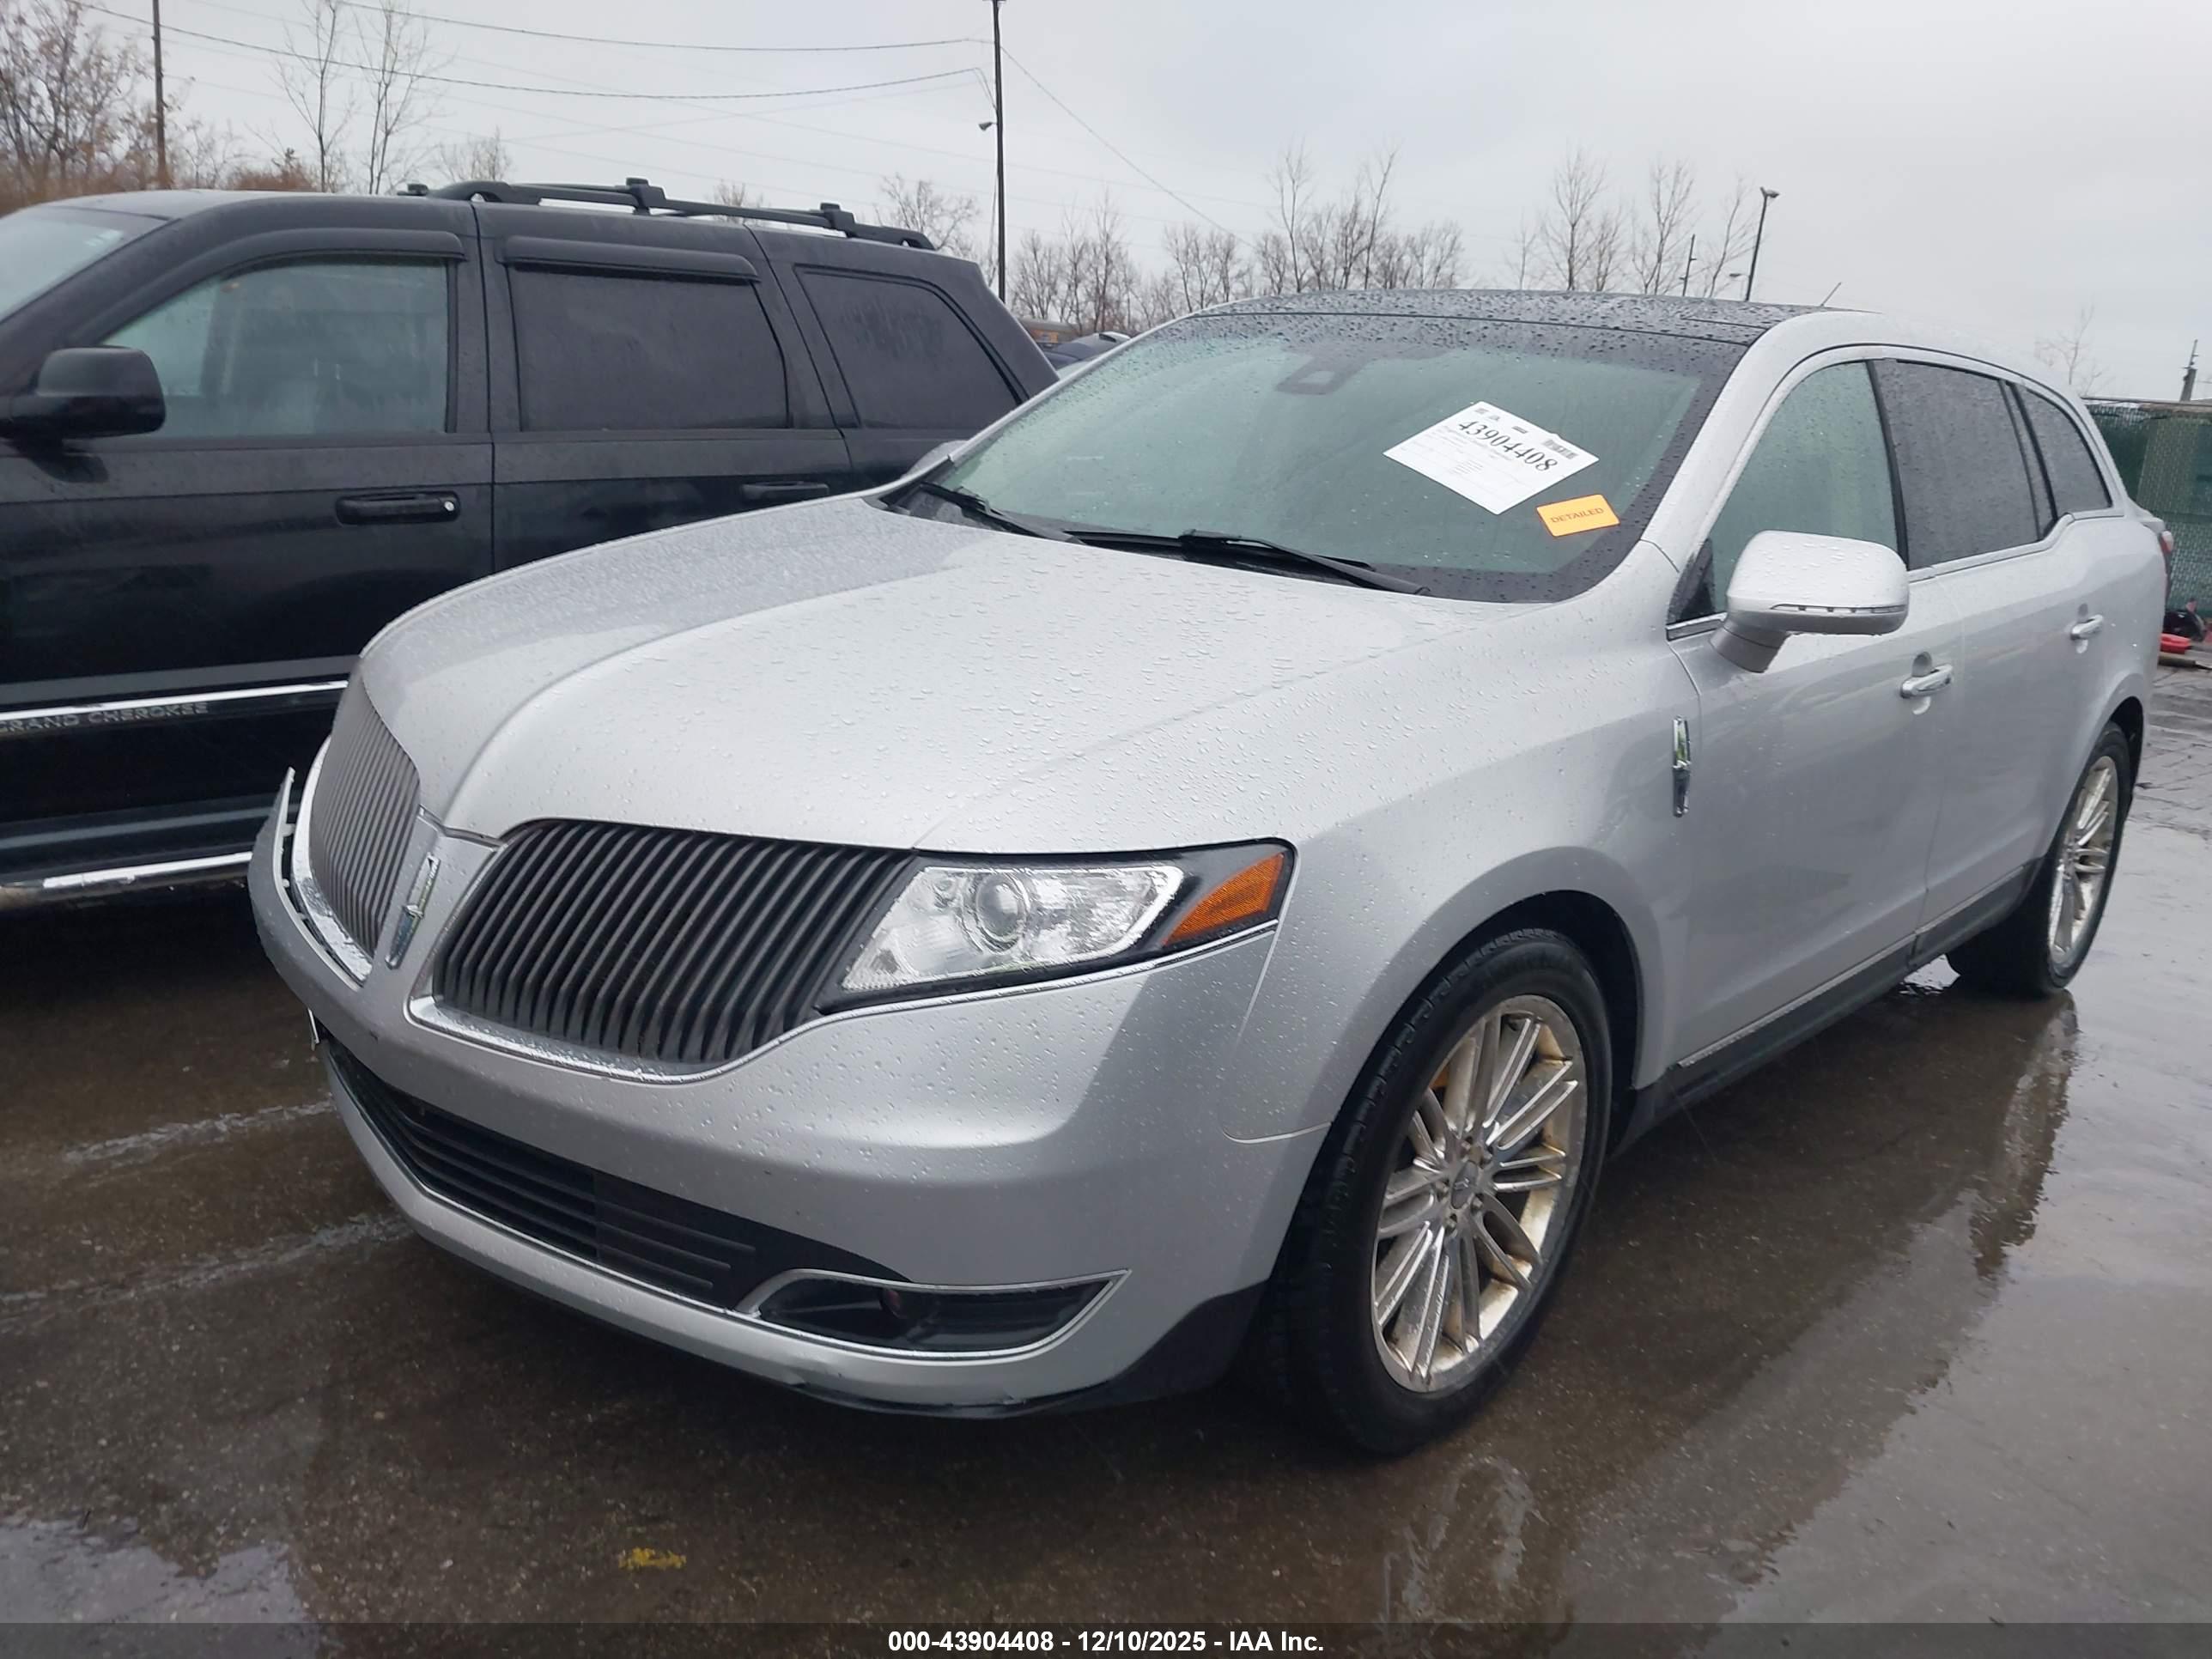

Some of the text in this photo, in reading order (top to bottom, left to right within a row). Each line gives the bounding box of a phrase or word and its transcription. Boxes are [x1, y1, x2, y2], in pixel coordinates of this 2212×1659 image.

[1458, 421, 1558, 471] 43904408
[1550, 507, 1605, 523] DETAILED
[88, 702, 209, 724] CHEROKEE
